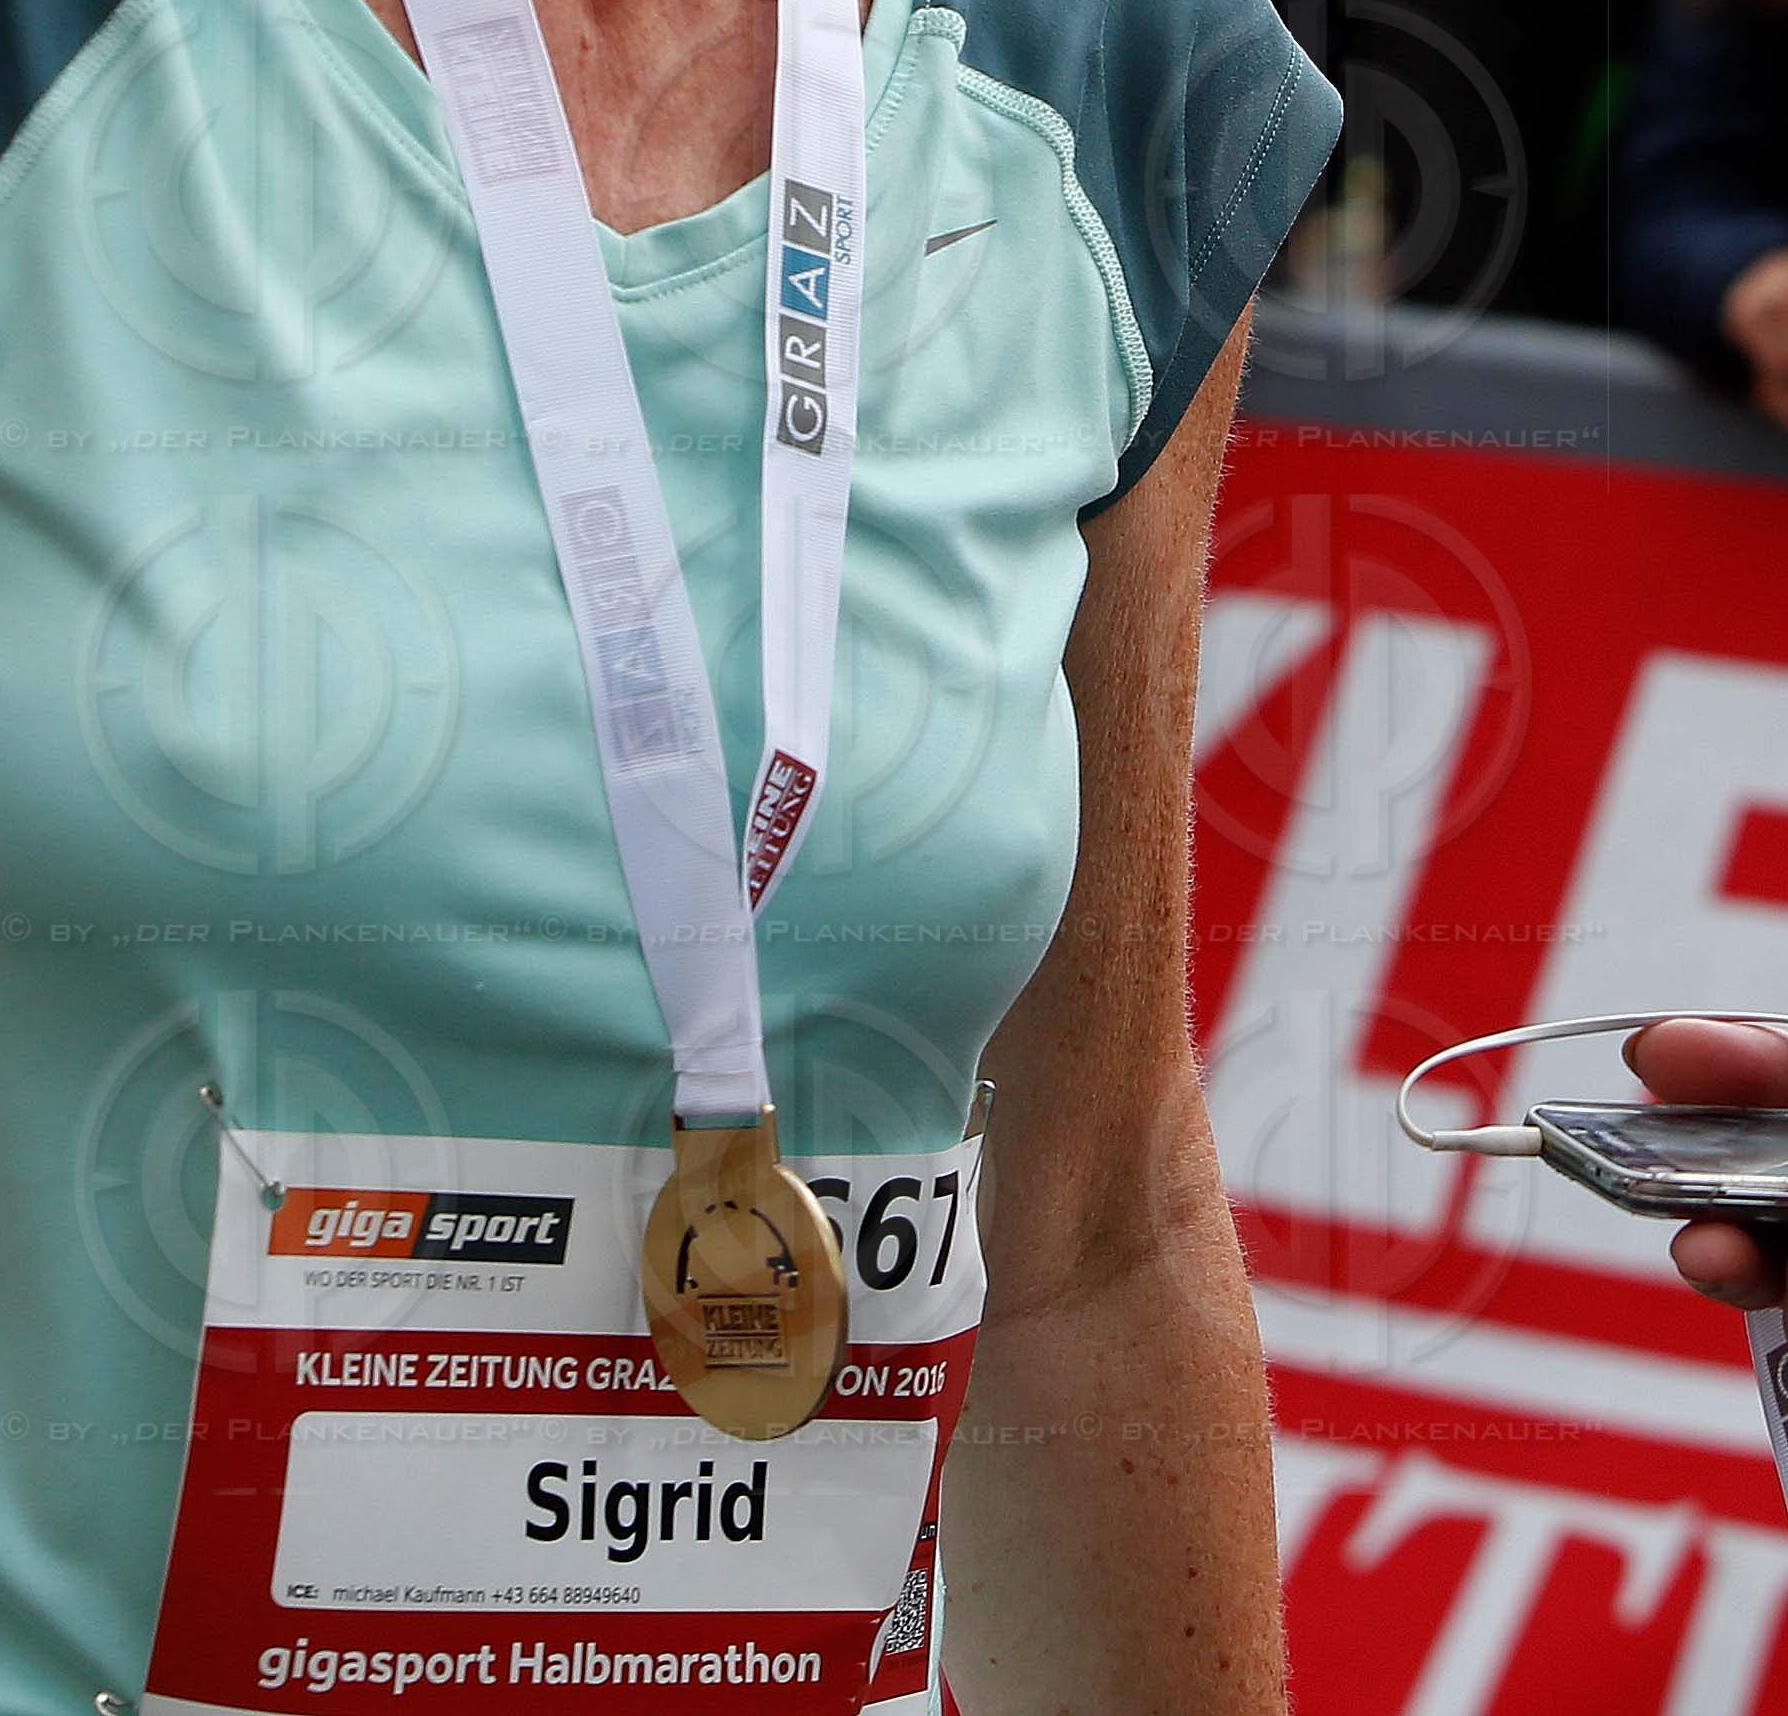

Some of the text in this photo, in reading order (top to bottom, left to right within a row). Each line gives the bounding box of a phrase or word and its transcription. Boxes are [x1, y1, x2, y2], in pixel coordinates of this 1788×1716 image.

[834, 194, 854, 266] SPORT
[784, 197, 828, 443] GRAZ
[305, 1200, 560, 1251] giga sport
[305, 1270, 332, 1287] WO
[336, 1270, 365, 1287] DER
[370, 1271, 423, 1289] SPORT
[427, 1273, 453, 1290] DIE
[488, 1276, 495, 1291] 1
[500, 1275, 526, 1292] IST
[295, 1352, 419, 1387] KLEINE
[424, 1354, 578, 1390] ZEITUNG
[835, 1366, 890, 1398] ON
[893, 1362, 948, 1398] 2016
[525, 1460, 769, 1562] Sigrid
[332, 1583, 399, 1603] michael
[402, 1584, 485, 1604] Kaufmann
[490, 1587, 524, 1604] +43
[528, 1586, 558, 1604] 664
[562, 1586, 641, 1605] 88949640
[257, 1639, 822, 1695] gigasport Halbmarathon
